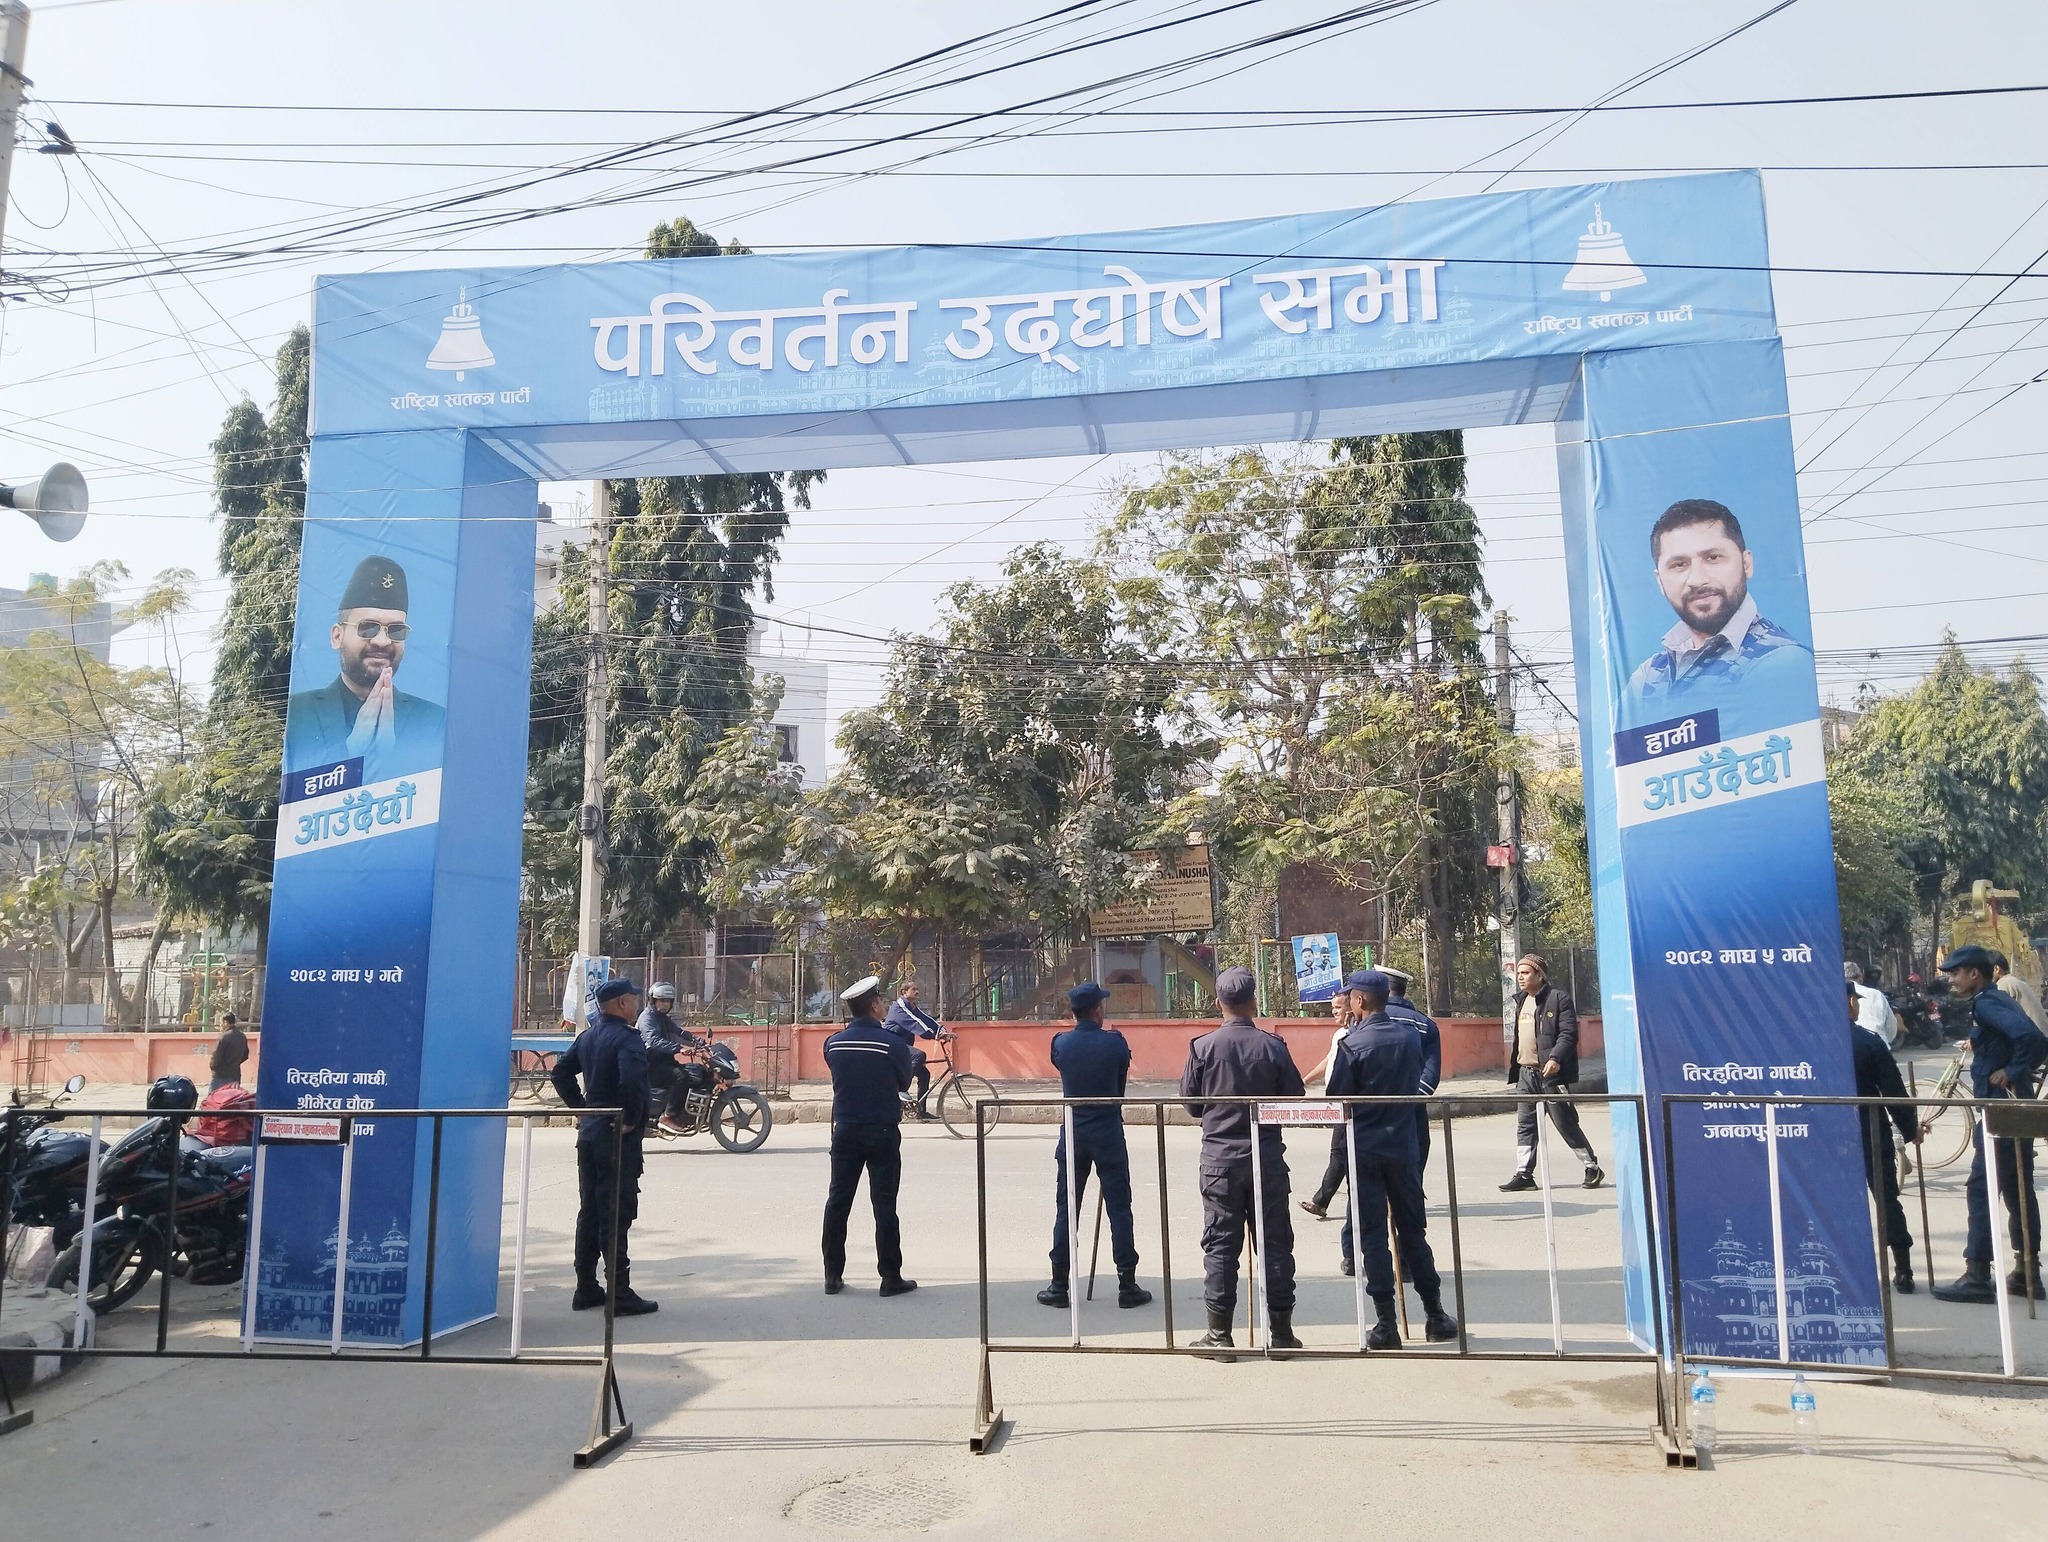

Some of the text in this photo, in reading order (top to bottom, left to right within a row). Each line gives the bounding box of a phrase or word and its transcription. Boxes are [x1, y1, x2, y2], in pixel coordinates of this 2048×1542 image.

[589, 289, 917, 377] परिवर्तन
[1253, 258, 1445, 334] सभा
[1588, 312, 1650, 329] स्वतन्त्र
[1656, 305, 1694, 323] पार्टी
[444, 393, 495, 408] स्वतन्त्र
[500, 387, 531, 404] पार्टी
[1644, 718, 1698, 754] हामी
[304, 764, 347, 796] हामी
[1643, 734, 1792, 810] आउँदैछौं
[295, 781, 417, 845] आउँदैछौं
[1665, 943, 1812, 965] २०८२ माघ ५ गते
[290, 966, 403, 984] २०८२ माघ ५ गते
[286, 1067, 350, 1088] तिरहुतिया
[1682, 1062, 1764, 1084] तिरहुतिया
[346, 1094, 375, 1110] चौक
